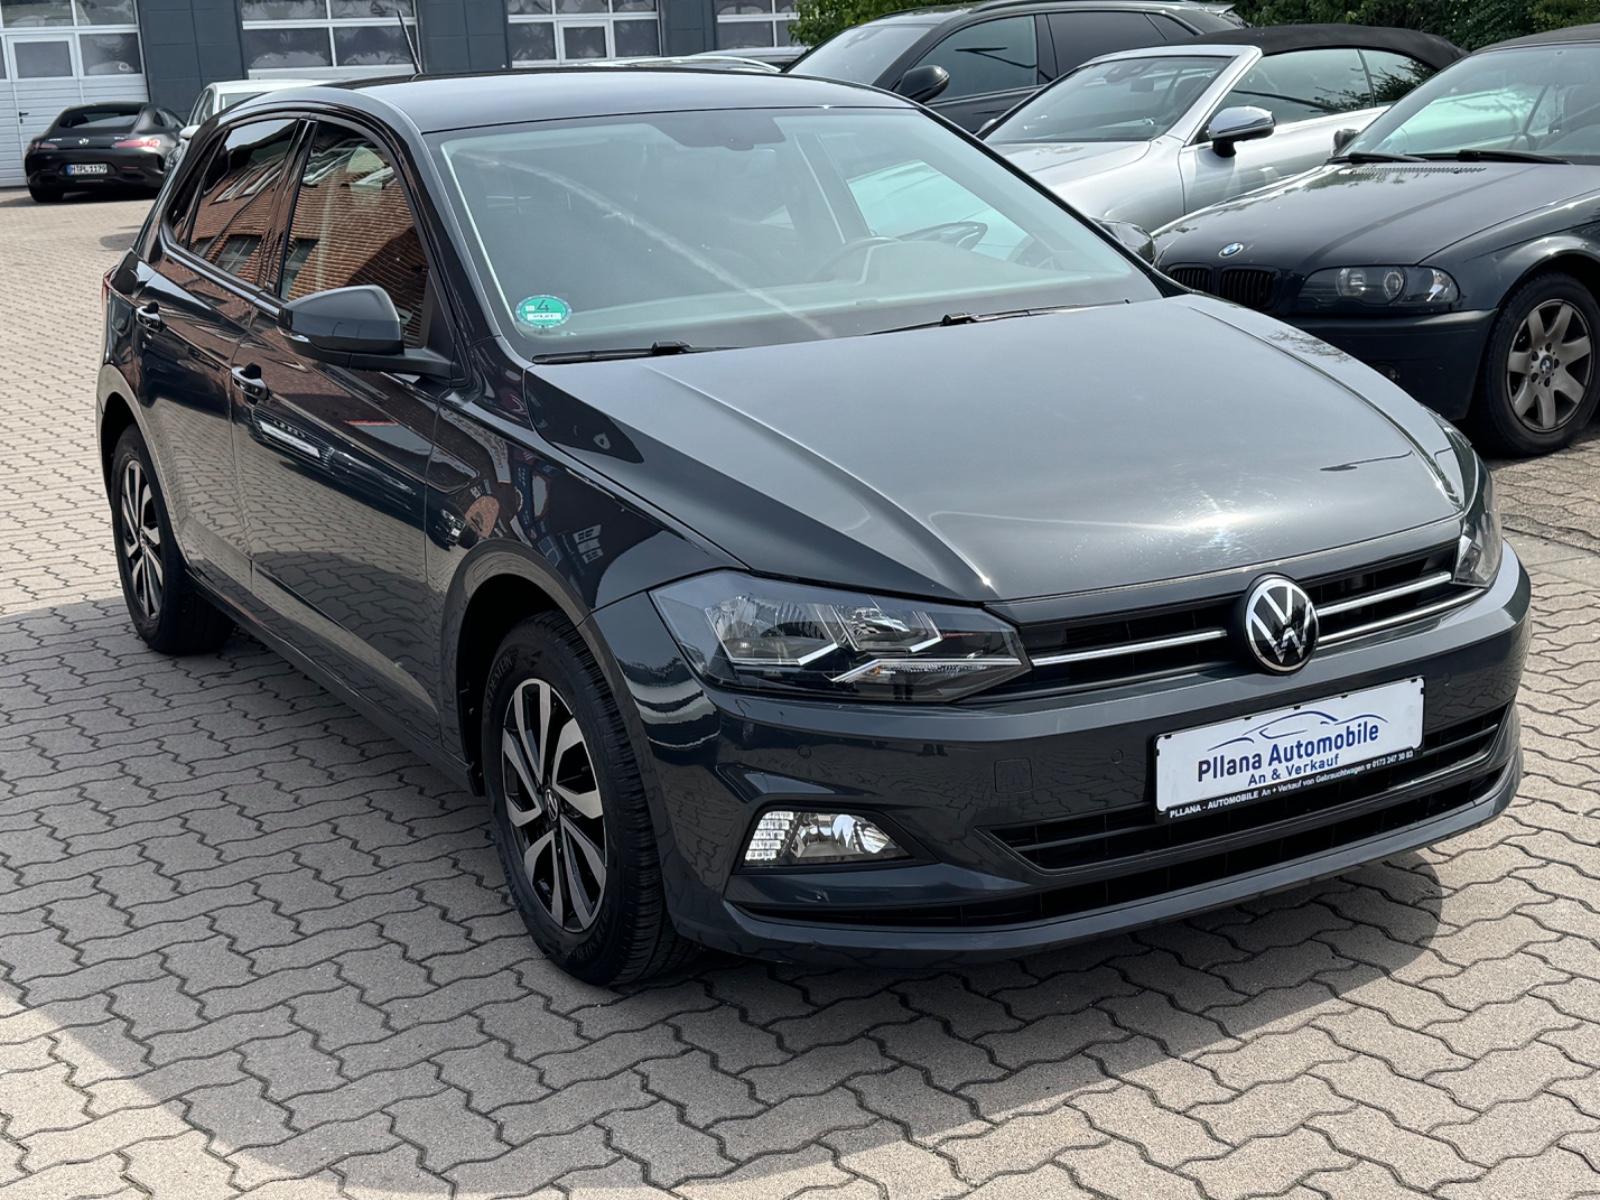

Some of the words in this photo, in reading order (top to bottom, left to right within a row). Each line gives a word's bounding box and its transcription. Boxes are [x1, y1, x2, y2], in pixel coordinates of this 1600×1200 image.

[536, 299, 550, 313] 4
[1267, 721, 1380, 766] Automobile
[1247, 773, 1267, 787] An
[1271, 767, 1281, 780] &
[1286, 753, 1340, 777] Verkauf
[1207, 790, 1259, 810] AUTOMOBILE
[1261, 788, 1271, 797] An
[1277, 780, 1302, 793] Verkauf
